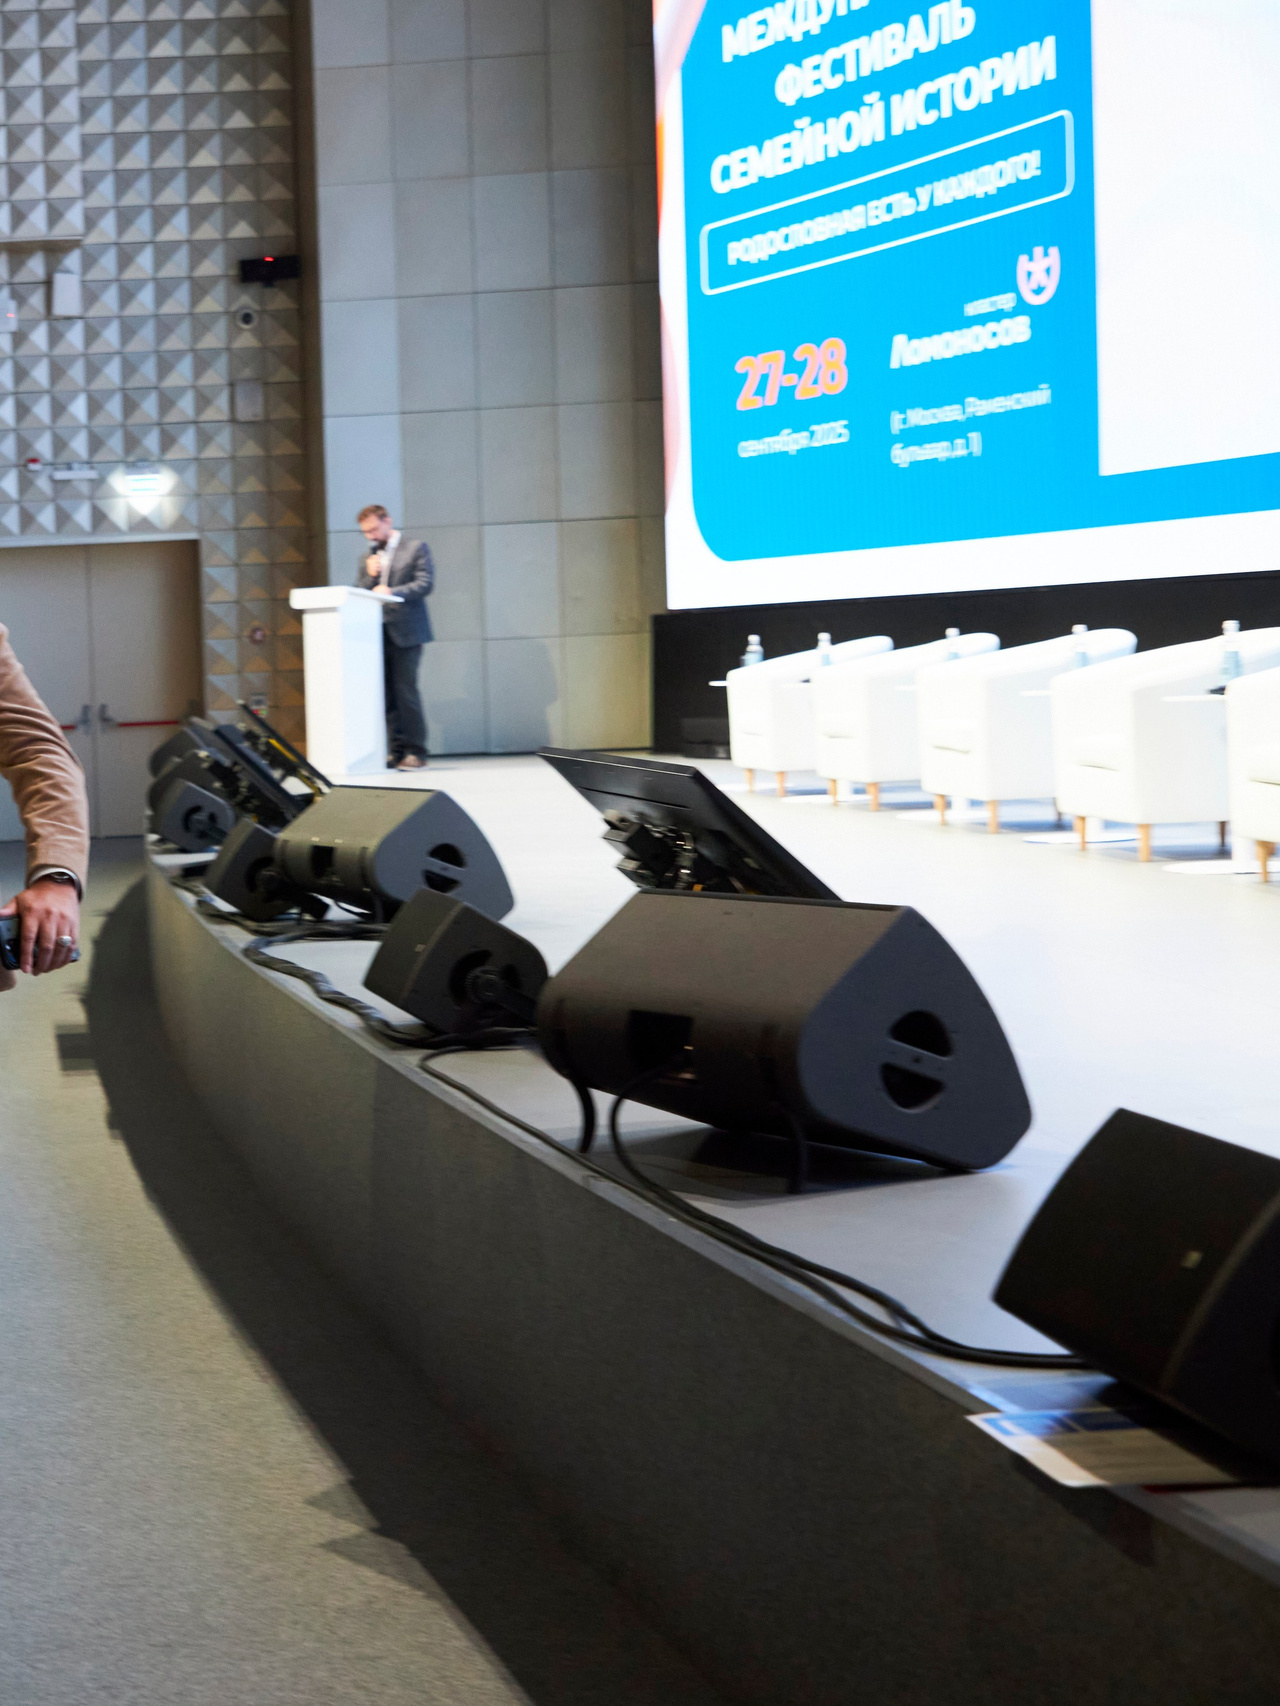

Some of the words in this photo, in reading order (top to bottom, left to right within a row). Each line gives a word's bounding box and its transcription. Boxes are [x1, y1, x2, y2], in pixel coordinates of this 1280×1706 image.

[722, 0, 871, 63] МЕЖДУ
[775, 0, 977, 107] ФЕСТИВАЛЬ
[710, 91, 885, 194] СЕМЕЙНОЙ
[890, 35, 1057, 136] ИСТОРИИ
[727, 204, 867, 266] РОДОСЛОВНАЯ
[867, 191, 917, 226] ЕСТЬ
[915, 184, 933, 212] У
[933, 150, 1041, 206] КАЖДОГО!
[734, 337, 849, 411] 27-28
[889, 315, 1032, 370] Ломоносов
